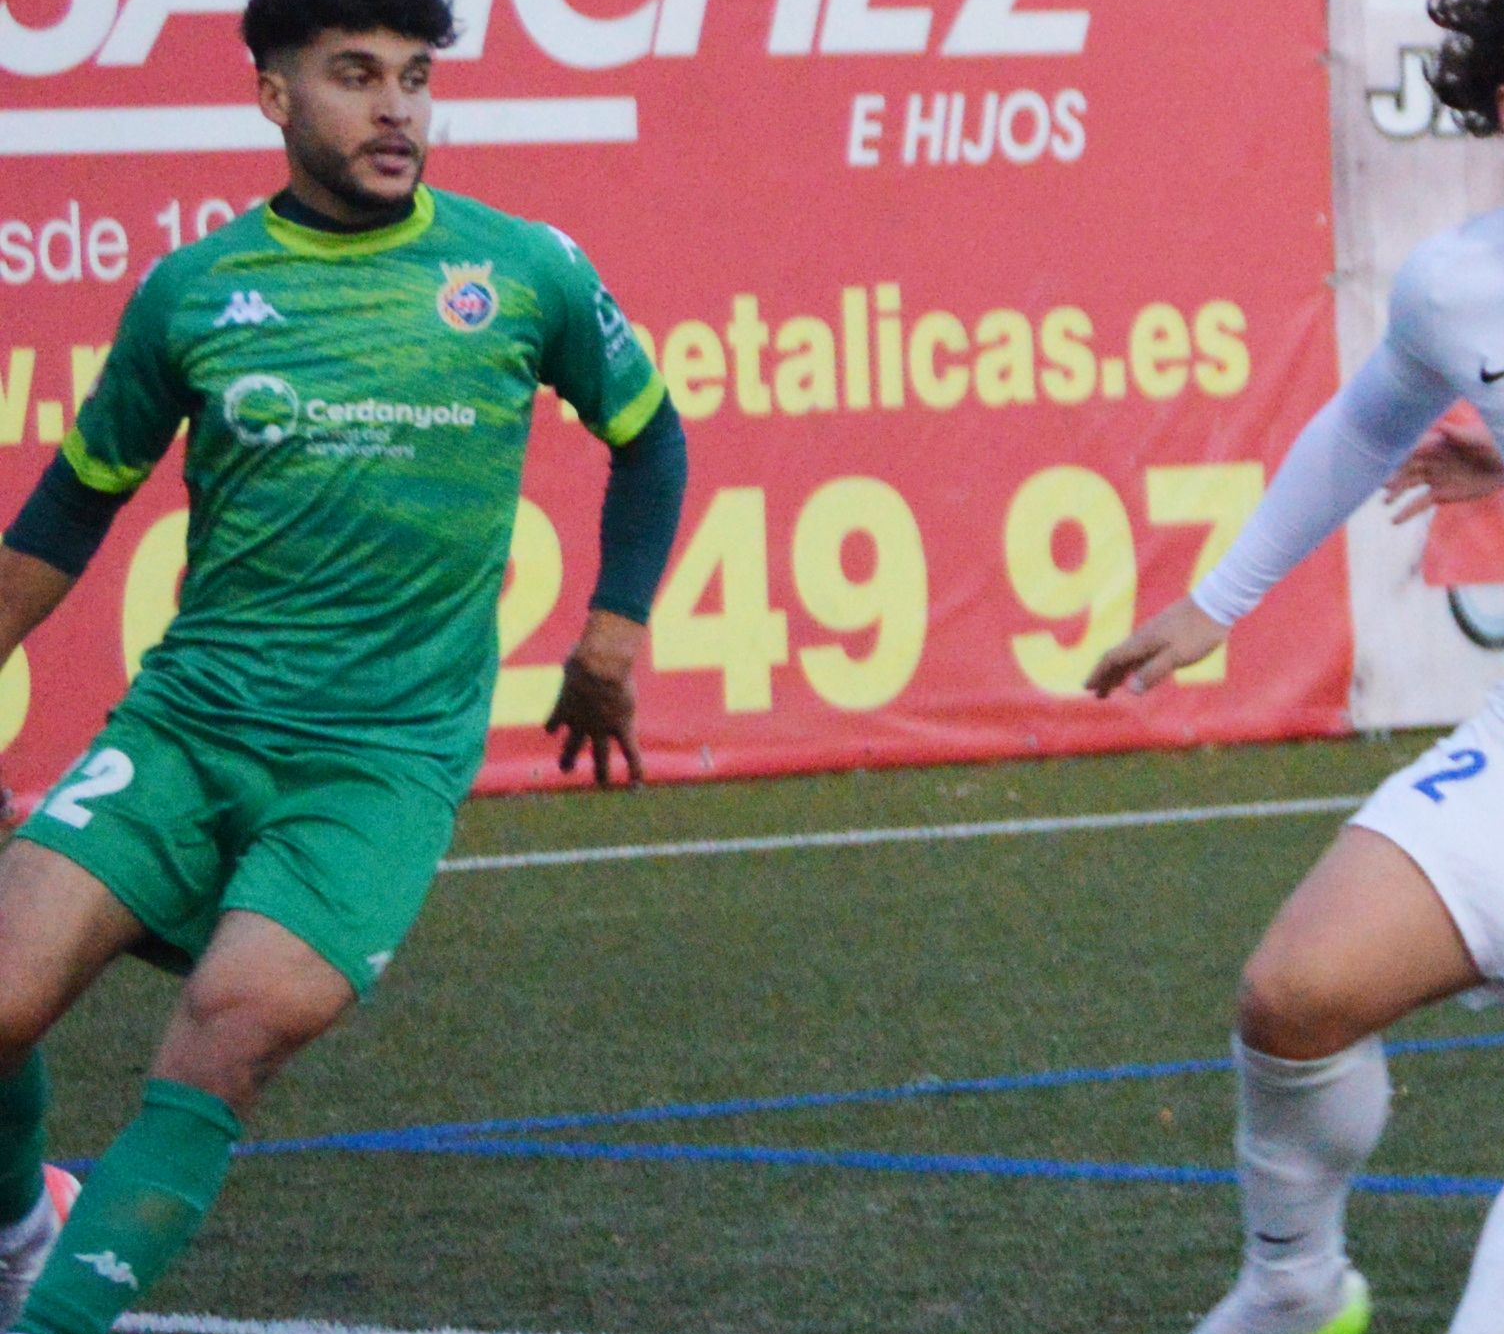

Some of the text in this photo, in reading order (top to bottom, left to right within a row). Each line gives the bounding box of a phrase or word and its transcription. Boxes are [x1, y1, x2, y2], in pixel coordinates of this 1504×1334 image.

[848, 89, 1088, 166] E HIJOS
[306, 398, 477, 430] Cerdanyola
[651, 476, 928, 715] 49
[1005, 462, 1265, 700] 97
[1412, 748, 1487, 803] 2
